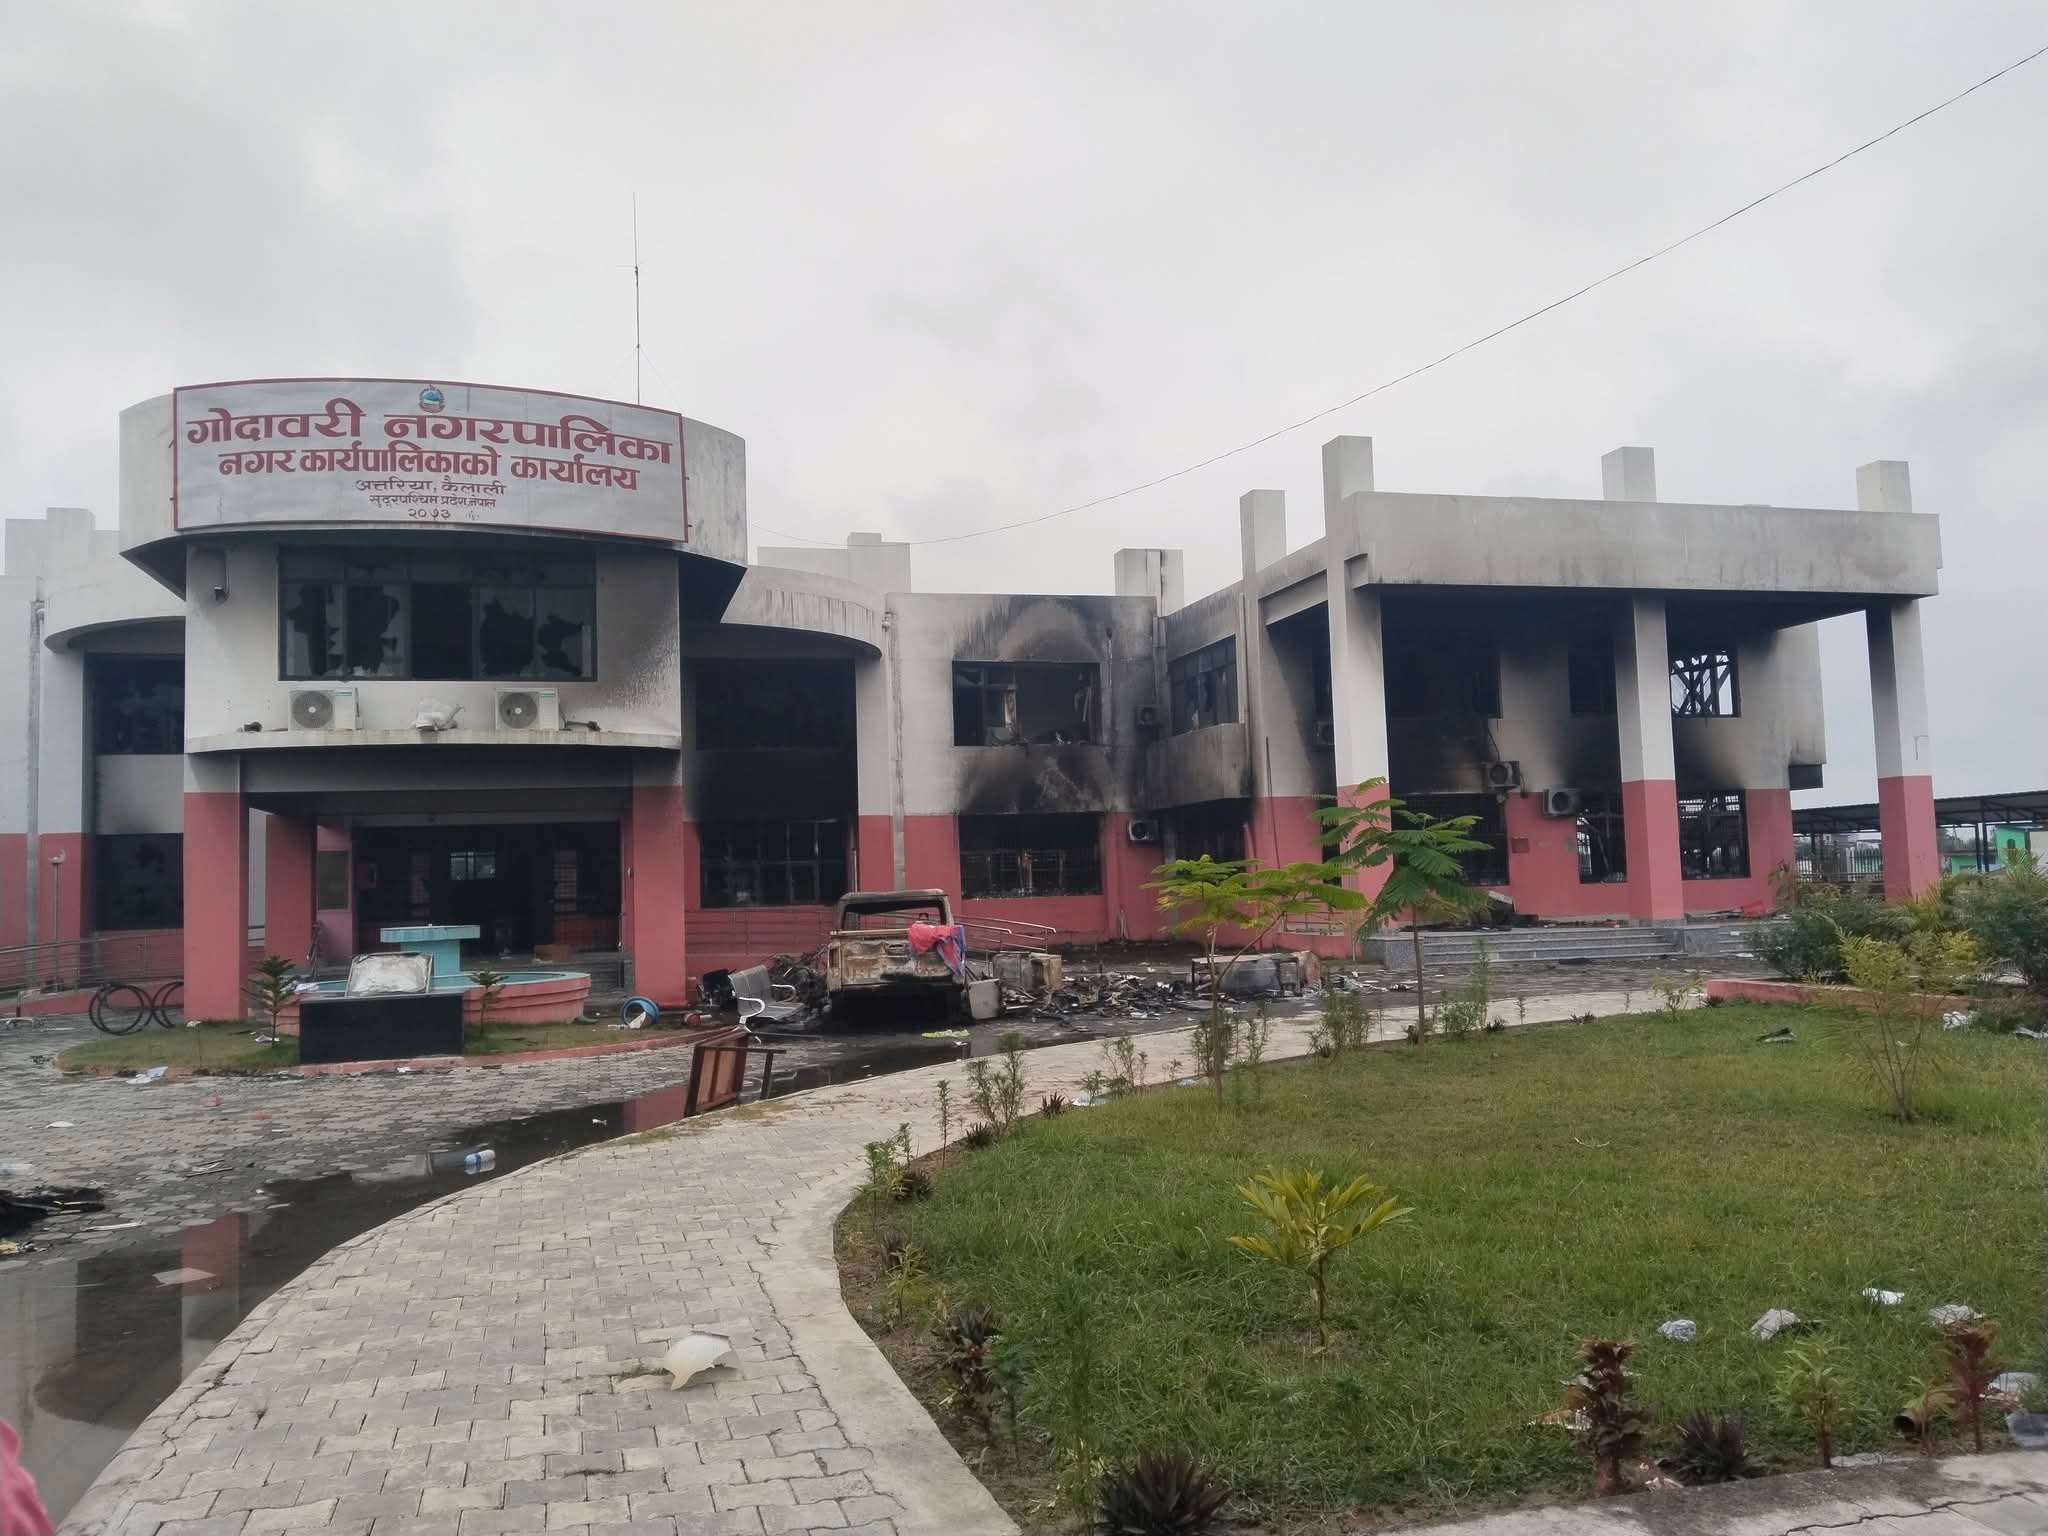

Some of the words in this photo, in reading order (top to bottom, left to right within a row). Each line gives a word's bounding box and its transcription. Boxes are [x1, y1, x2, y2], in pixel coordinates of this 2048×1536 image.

[186, 398, 366, 444] गोदावरी
[384, 414, 673, 464] नगरपालिका
[218, 449, 296, 475] नगर
[300, 440, 501, 476] कार्यपालिकाको
[511, 453, 640, 490] कार्यालय
[441, 475, 506, 495] कैलाली
